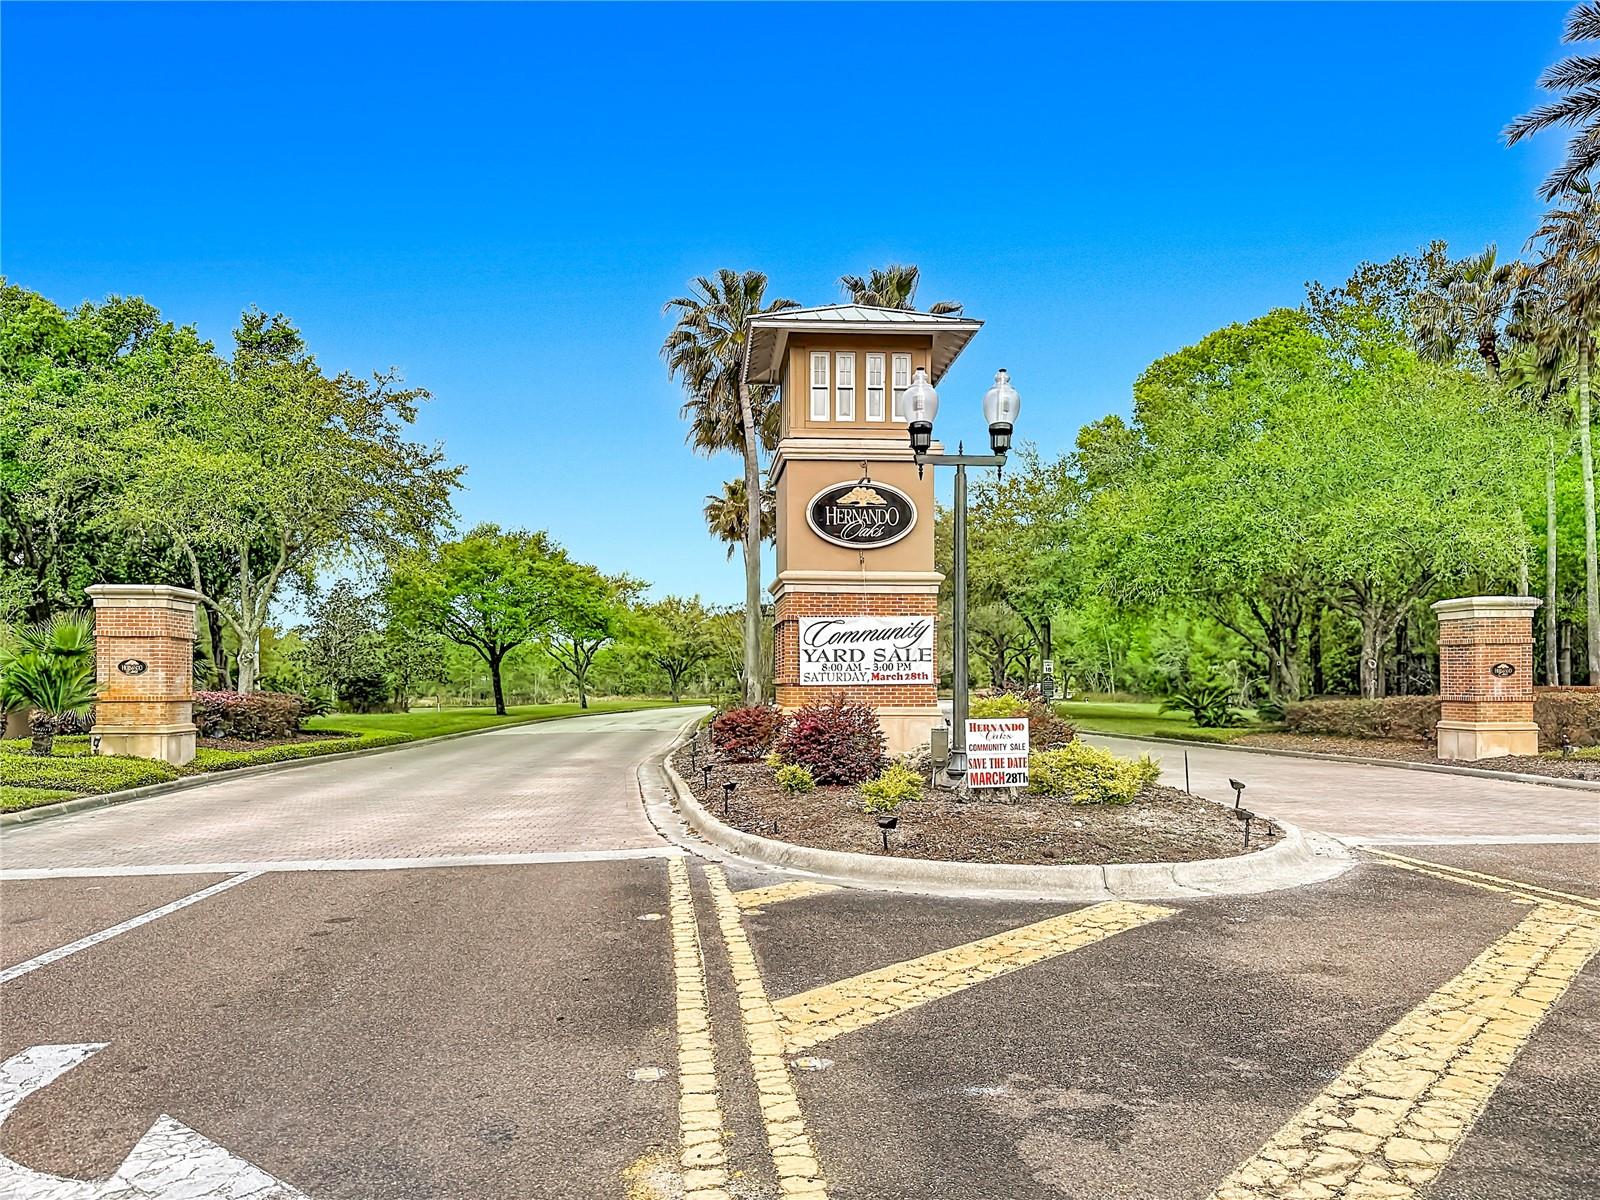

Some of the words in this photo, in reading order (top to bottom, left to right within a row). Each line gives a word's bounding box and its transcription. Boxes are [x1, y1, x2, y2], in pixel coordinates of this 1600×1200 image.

[825, 506, 900, 526] HERNANDO
[840, 520, 885, 540] Oaks
[803, 619, 931, 649] Community
[802, 648, 866, 663] YARD
[873, 647, 932, 662] SALE
[821, 663, 843, 672] 8:00
[845, 663, 862, 671] AM
[873, 662, 894, 671] 3:00
[896, 662, 912, 671] PM
[803, 672, 870, 683] SATURDAY,
[871, 672, 904, 681] March
[969, 722, 1025, 733] HERNANDO
[968, 743, 1007, 752] COMMUNITY
[1009, 742, 1026, 751] SALE
[968, 758, 987, 770] SAVE
[989, 757, 1006, 769] THE
[1007, 757, 1028, 769] DATE
[969, 771, 1006, 786] MARCH
